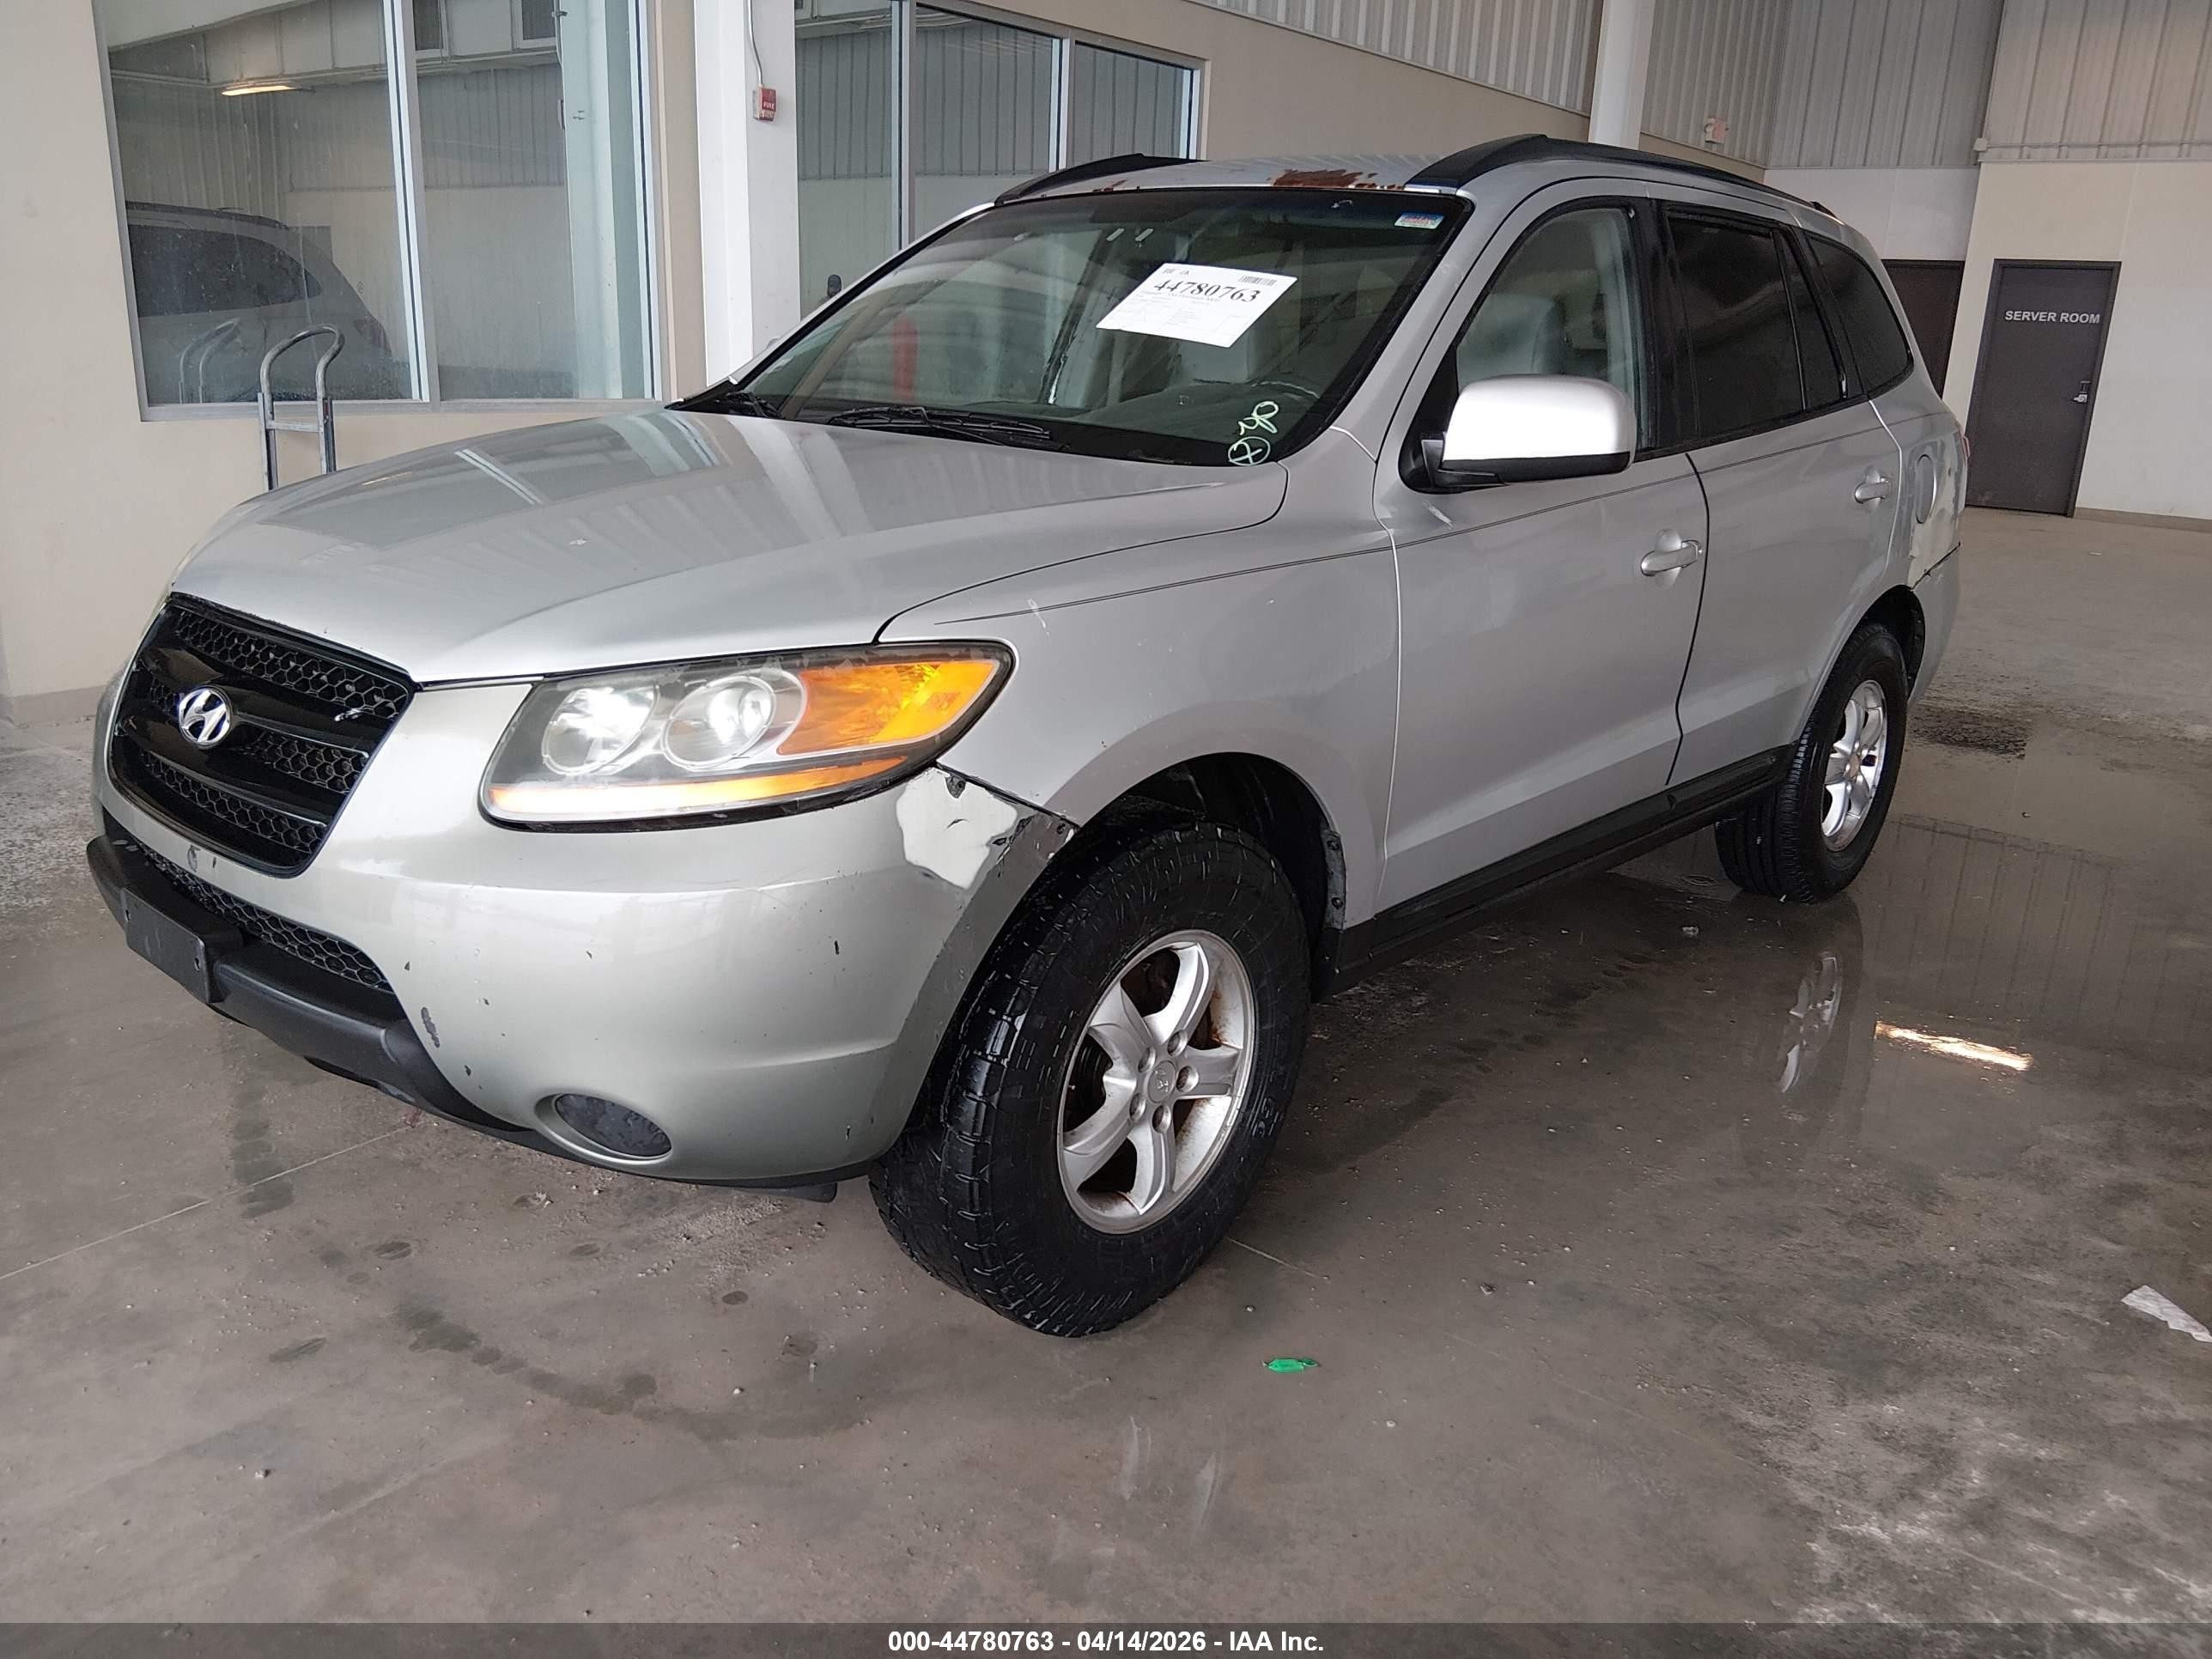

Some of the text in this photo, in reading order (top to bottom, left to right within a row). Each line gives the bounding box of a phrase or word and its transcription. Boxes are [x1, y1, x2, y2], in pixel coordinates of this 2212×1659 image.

[763, 101, 775, 110] FIRE
[1153, 279, 1261, 302] 44780763
[2004, 310, 2101, 324] SERVER ROOM
